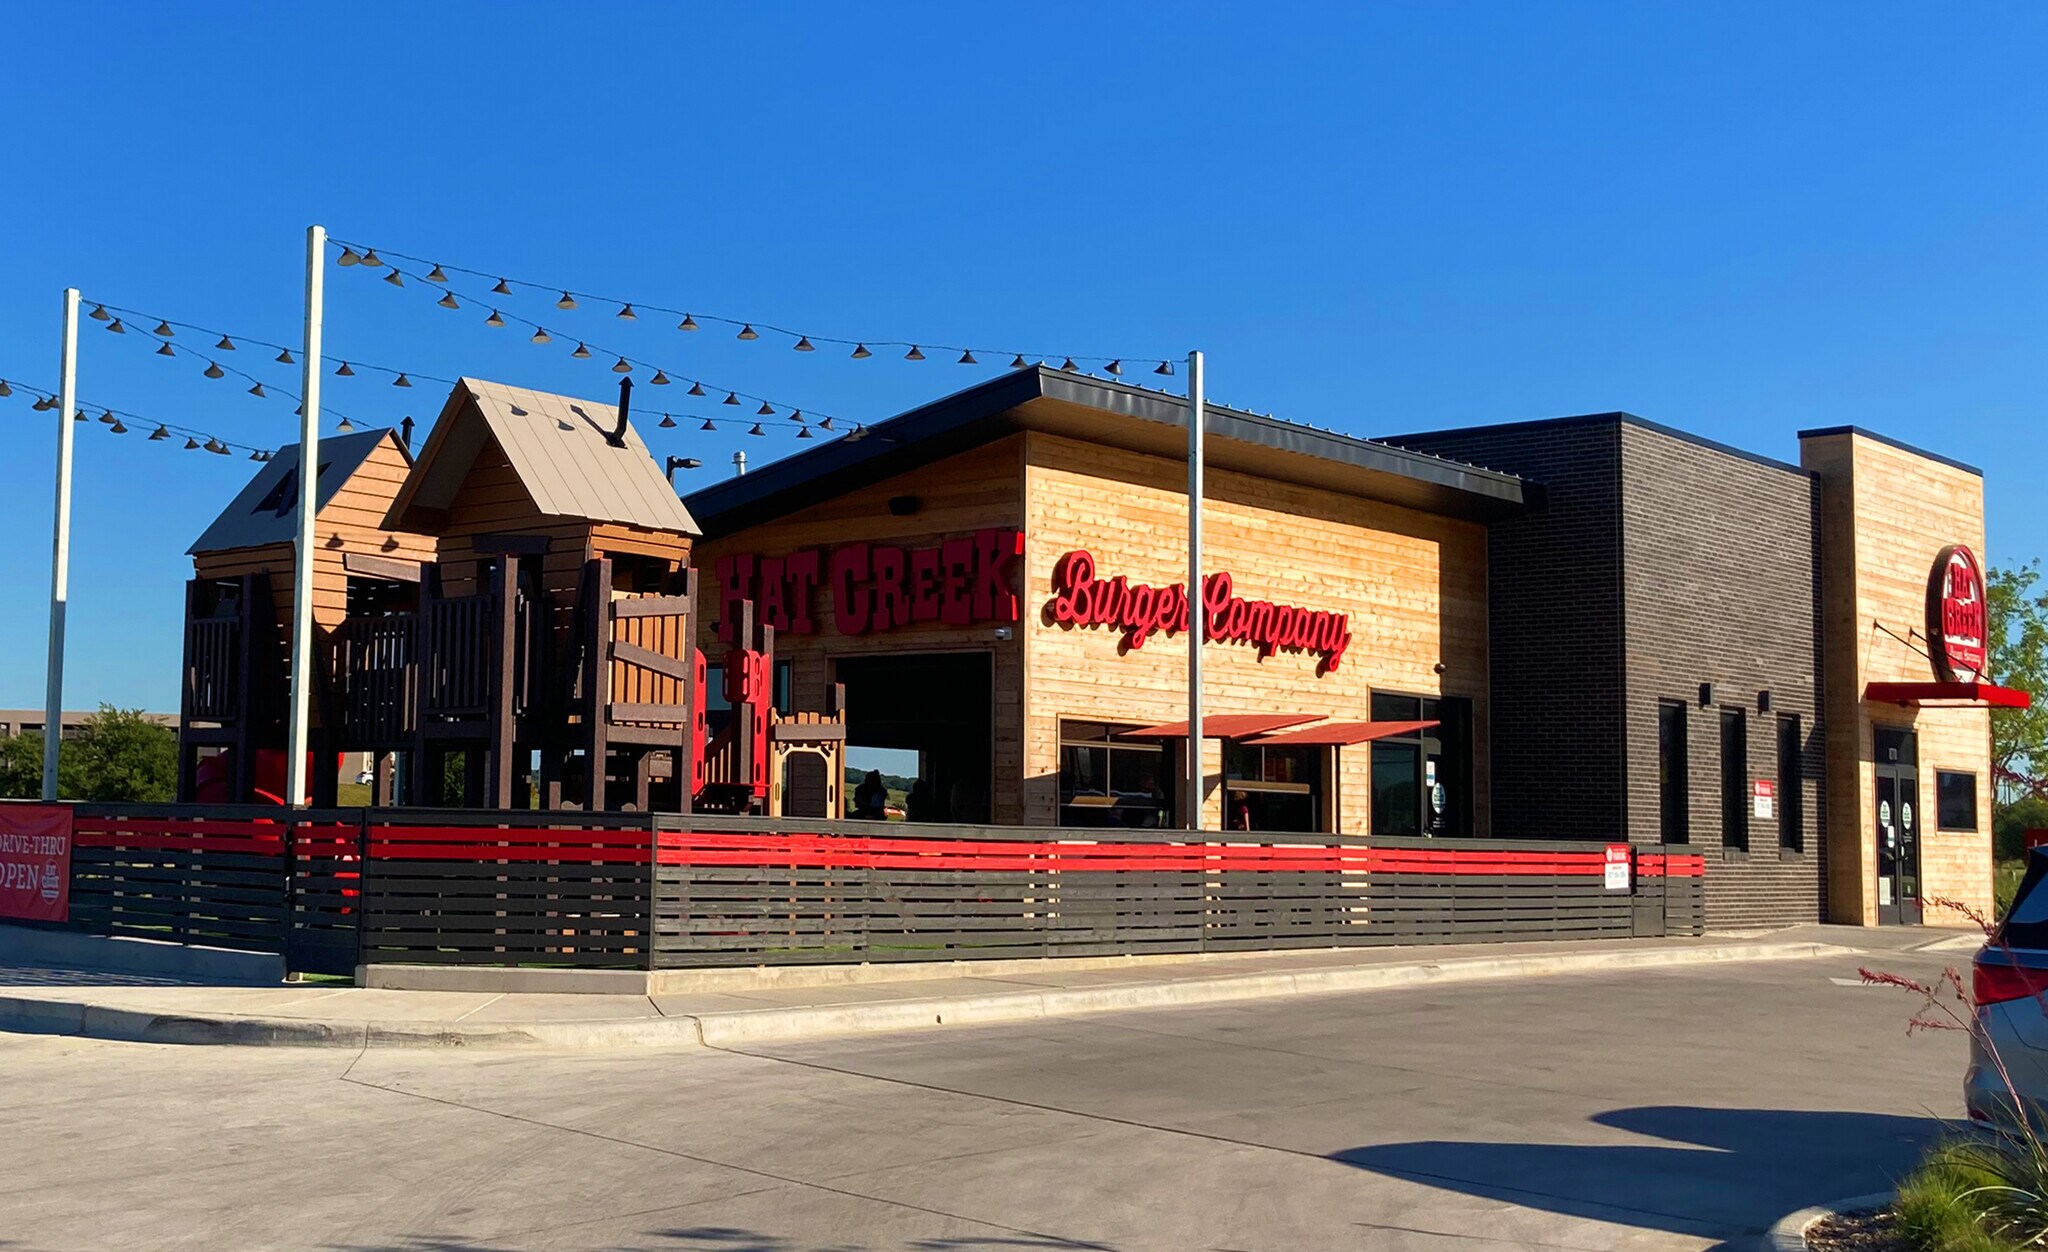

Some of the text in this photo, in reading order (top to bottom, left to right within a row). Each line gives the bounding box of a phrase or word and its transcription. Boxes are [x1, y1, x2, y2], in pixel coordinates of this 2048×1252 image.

[715, 528, 1024, 643] HAT CREEK
[1055, 549, 1351, 673] Burger Company
